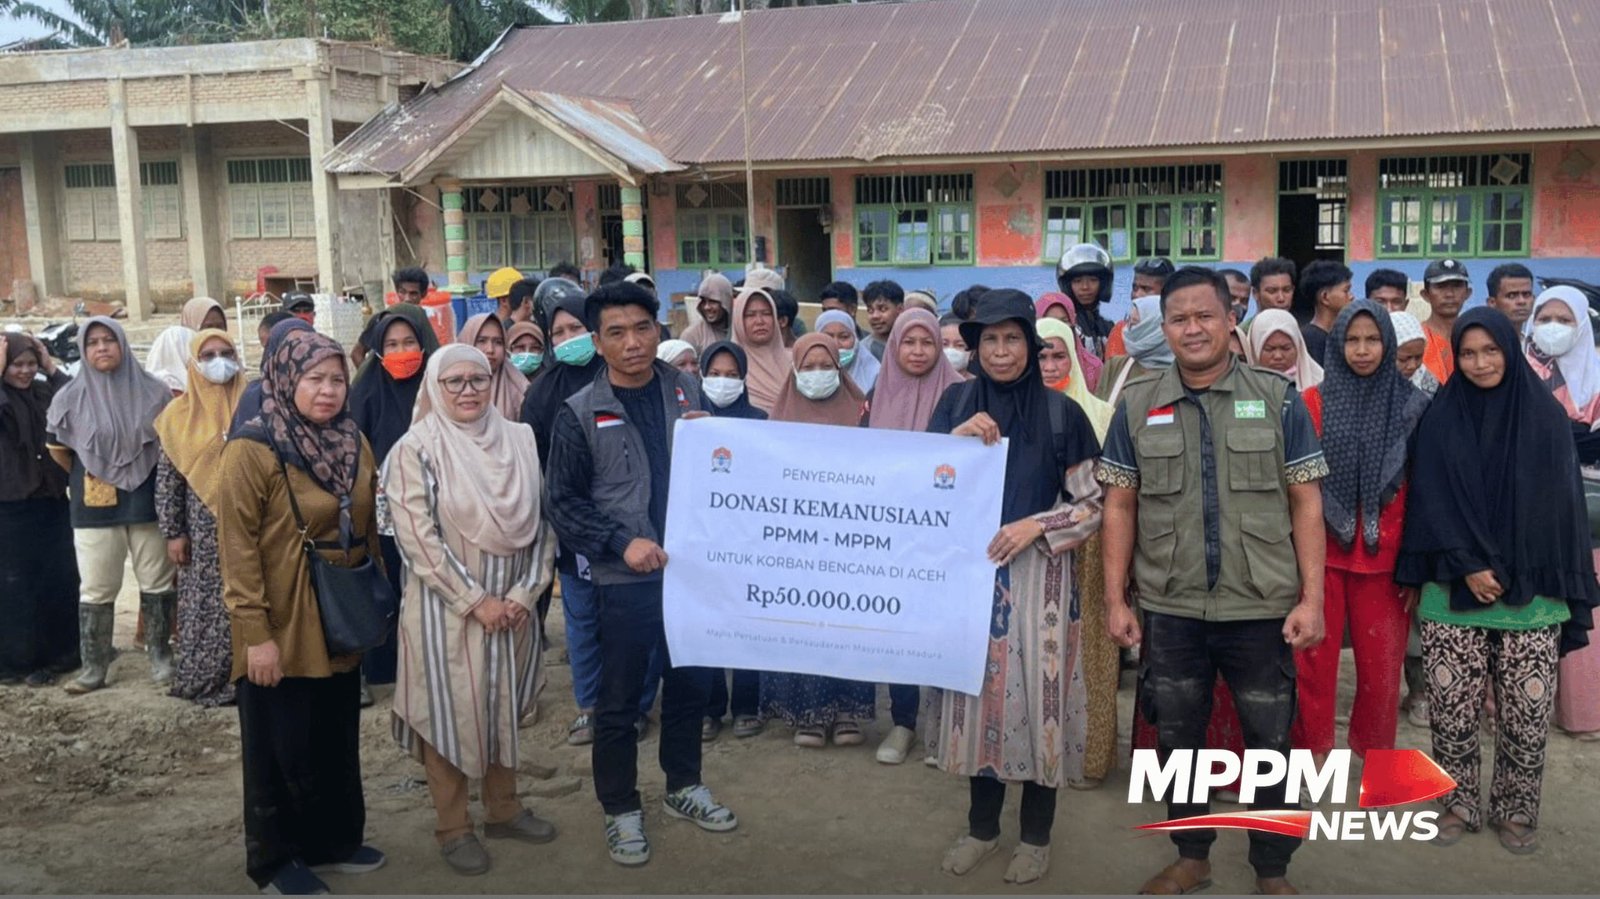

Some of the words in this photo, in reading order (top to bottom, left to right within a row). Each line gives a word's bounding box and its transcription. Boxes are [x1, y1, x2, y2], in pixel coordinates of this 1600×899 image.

[782, 468, 876, 486] PENYERAHAN
[709, 491, 788, 515] DONASI
[793, 499, 950, 528] KEMANUSIAAN
[763, 525, 818, 545] PPMM
[835, 532, 891, 551] MPPM
[707, 551, 753, 566] UNTUK
[756, 555, 814, 569] KORBAN
[818, 560, 886, 577] BENCANA
[889, 566, 904, 578] DI
[907, 568, 946, 582] ACEH
[746, 583, 901, 616] Rp50.000.000
